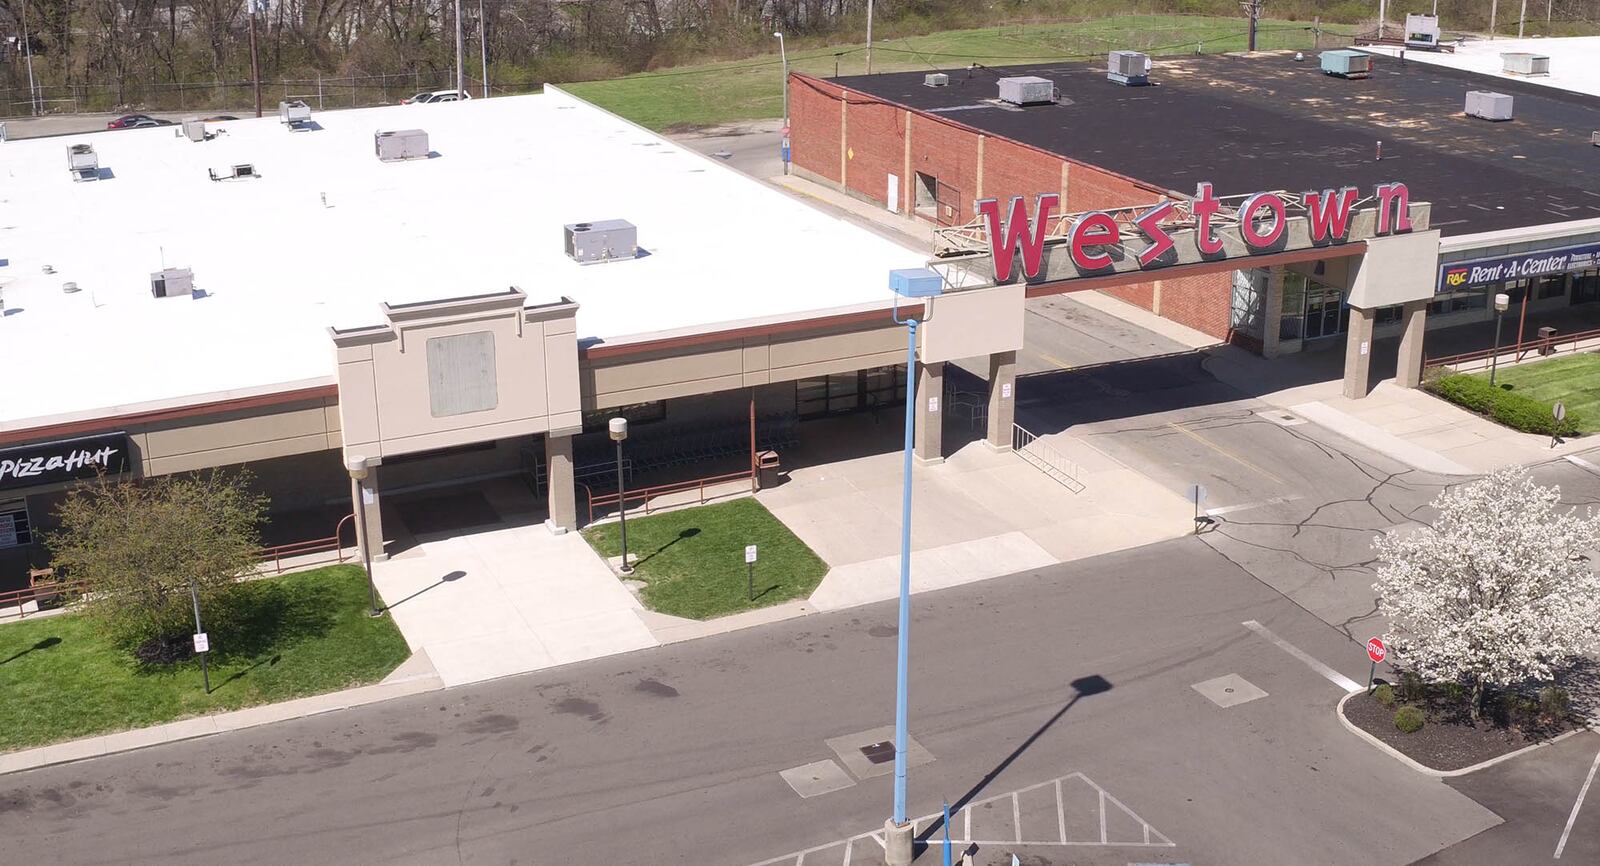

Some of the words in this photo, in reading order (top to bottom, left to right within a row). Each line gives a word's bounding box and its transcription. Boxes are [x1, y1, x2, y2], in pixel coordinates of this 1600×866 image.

[975, 182, 1413, 281] Westown
[1446, 272, 1467, 286] RAC
[1368, 642, 1385, 657] STOP
